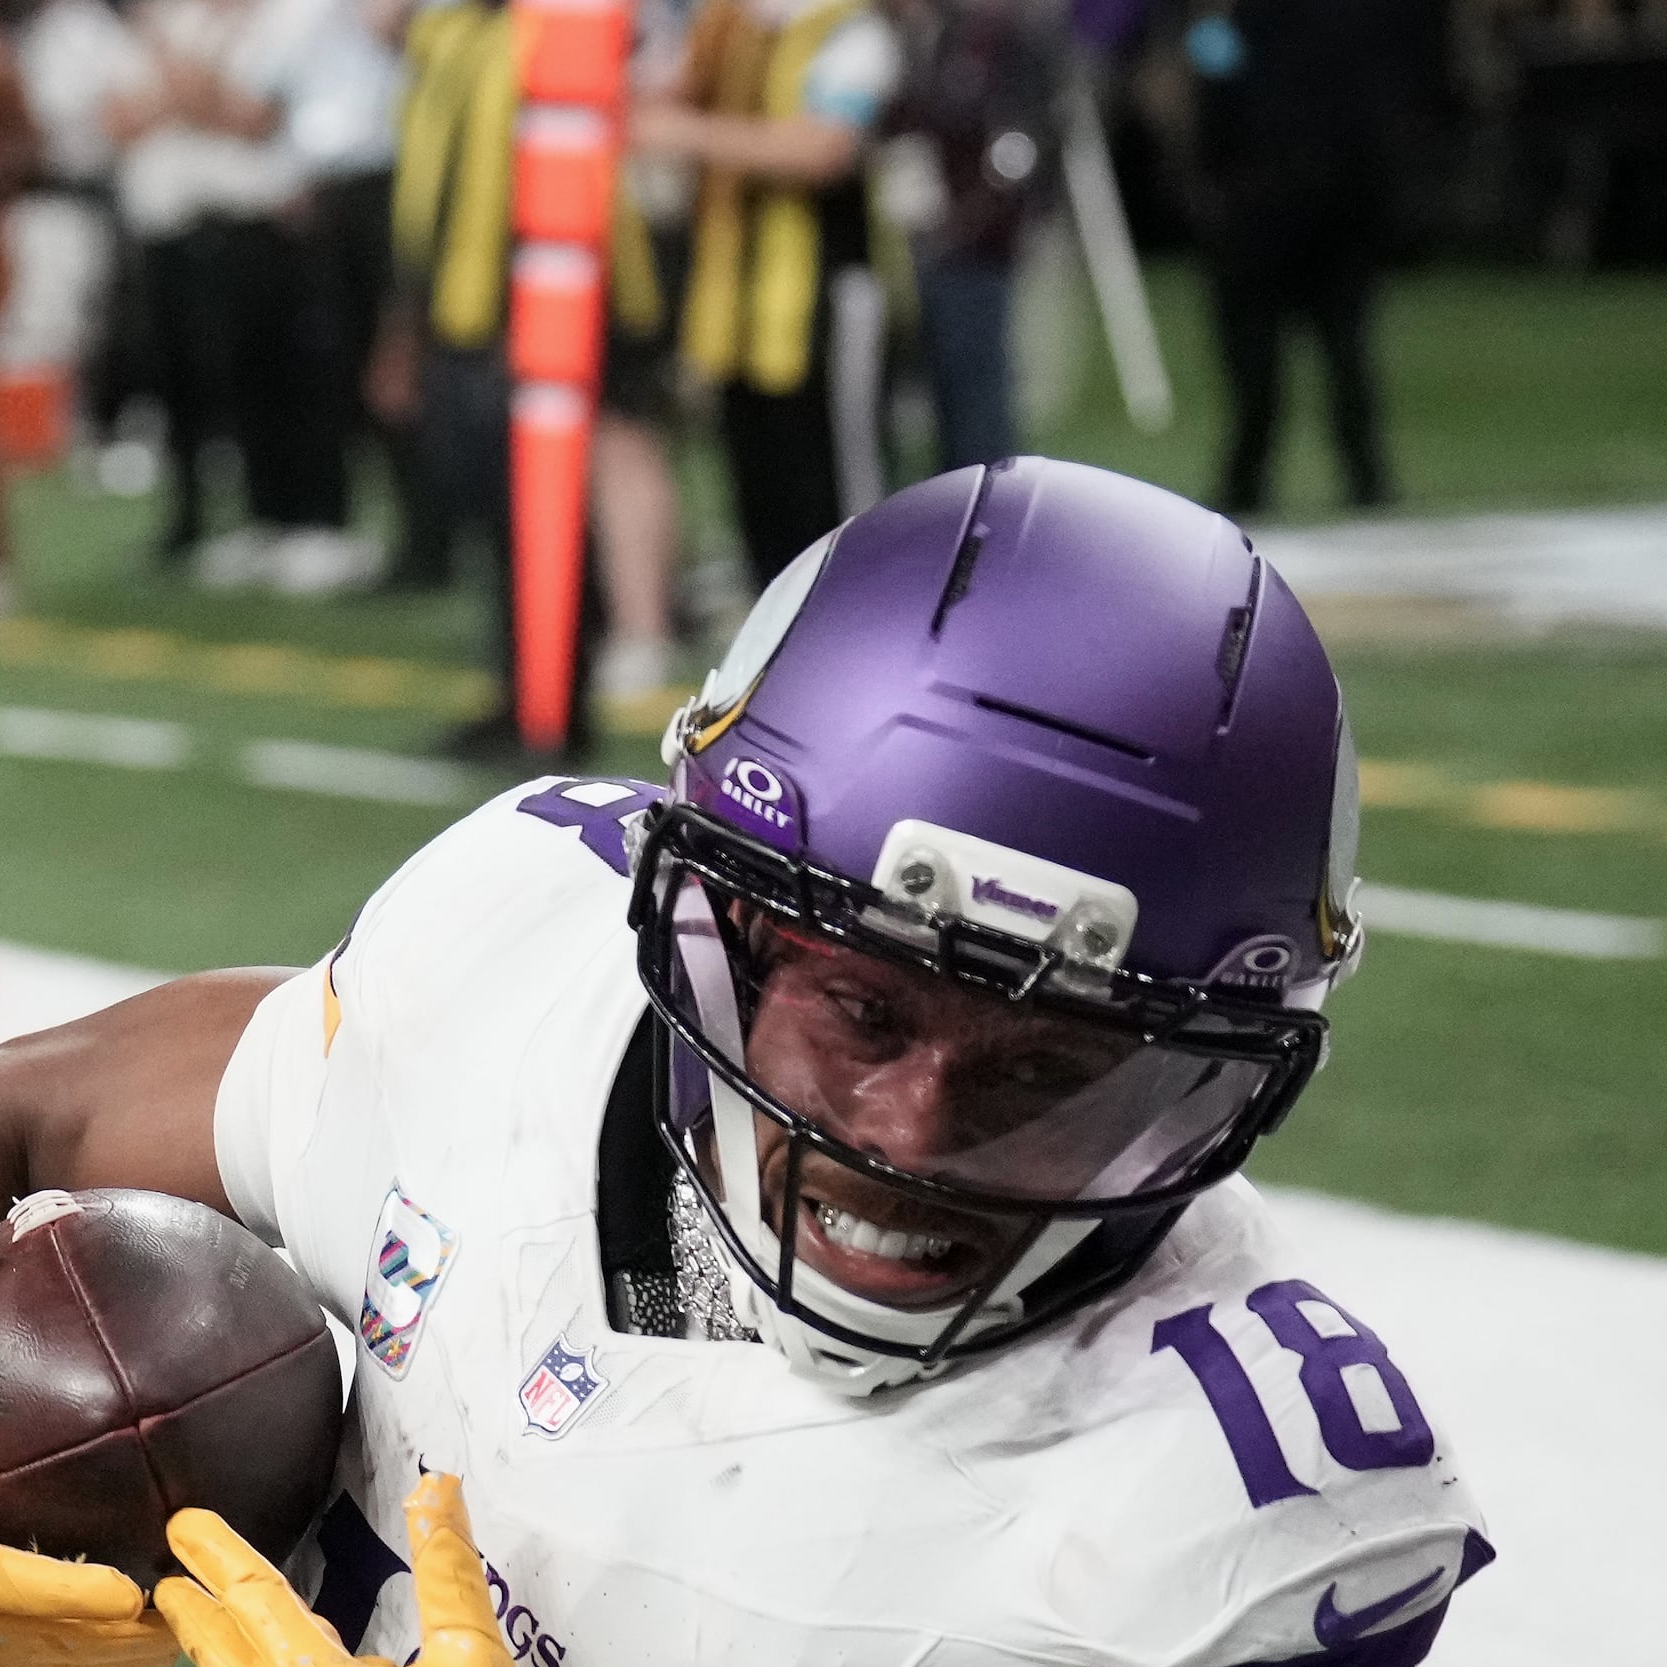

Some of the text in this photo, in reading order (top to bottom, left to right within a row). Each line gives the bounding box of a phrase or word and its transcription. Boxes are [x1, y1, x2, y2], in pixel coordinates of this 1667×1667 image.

[720, 777, 795, 829] OAKLEY
[523, 1370, 572, 1427] NFL
[1150, 1278, 1436, 1510] 18
